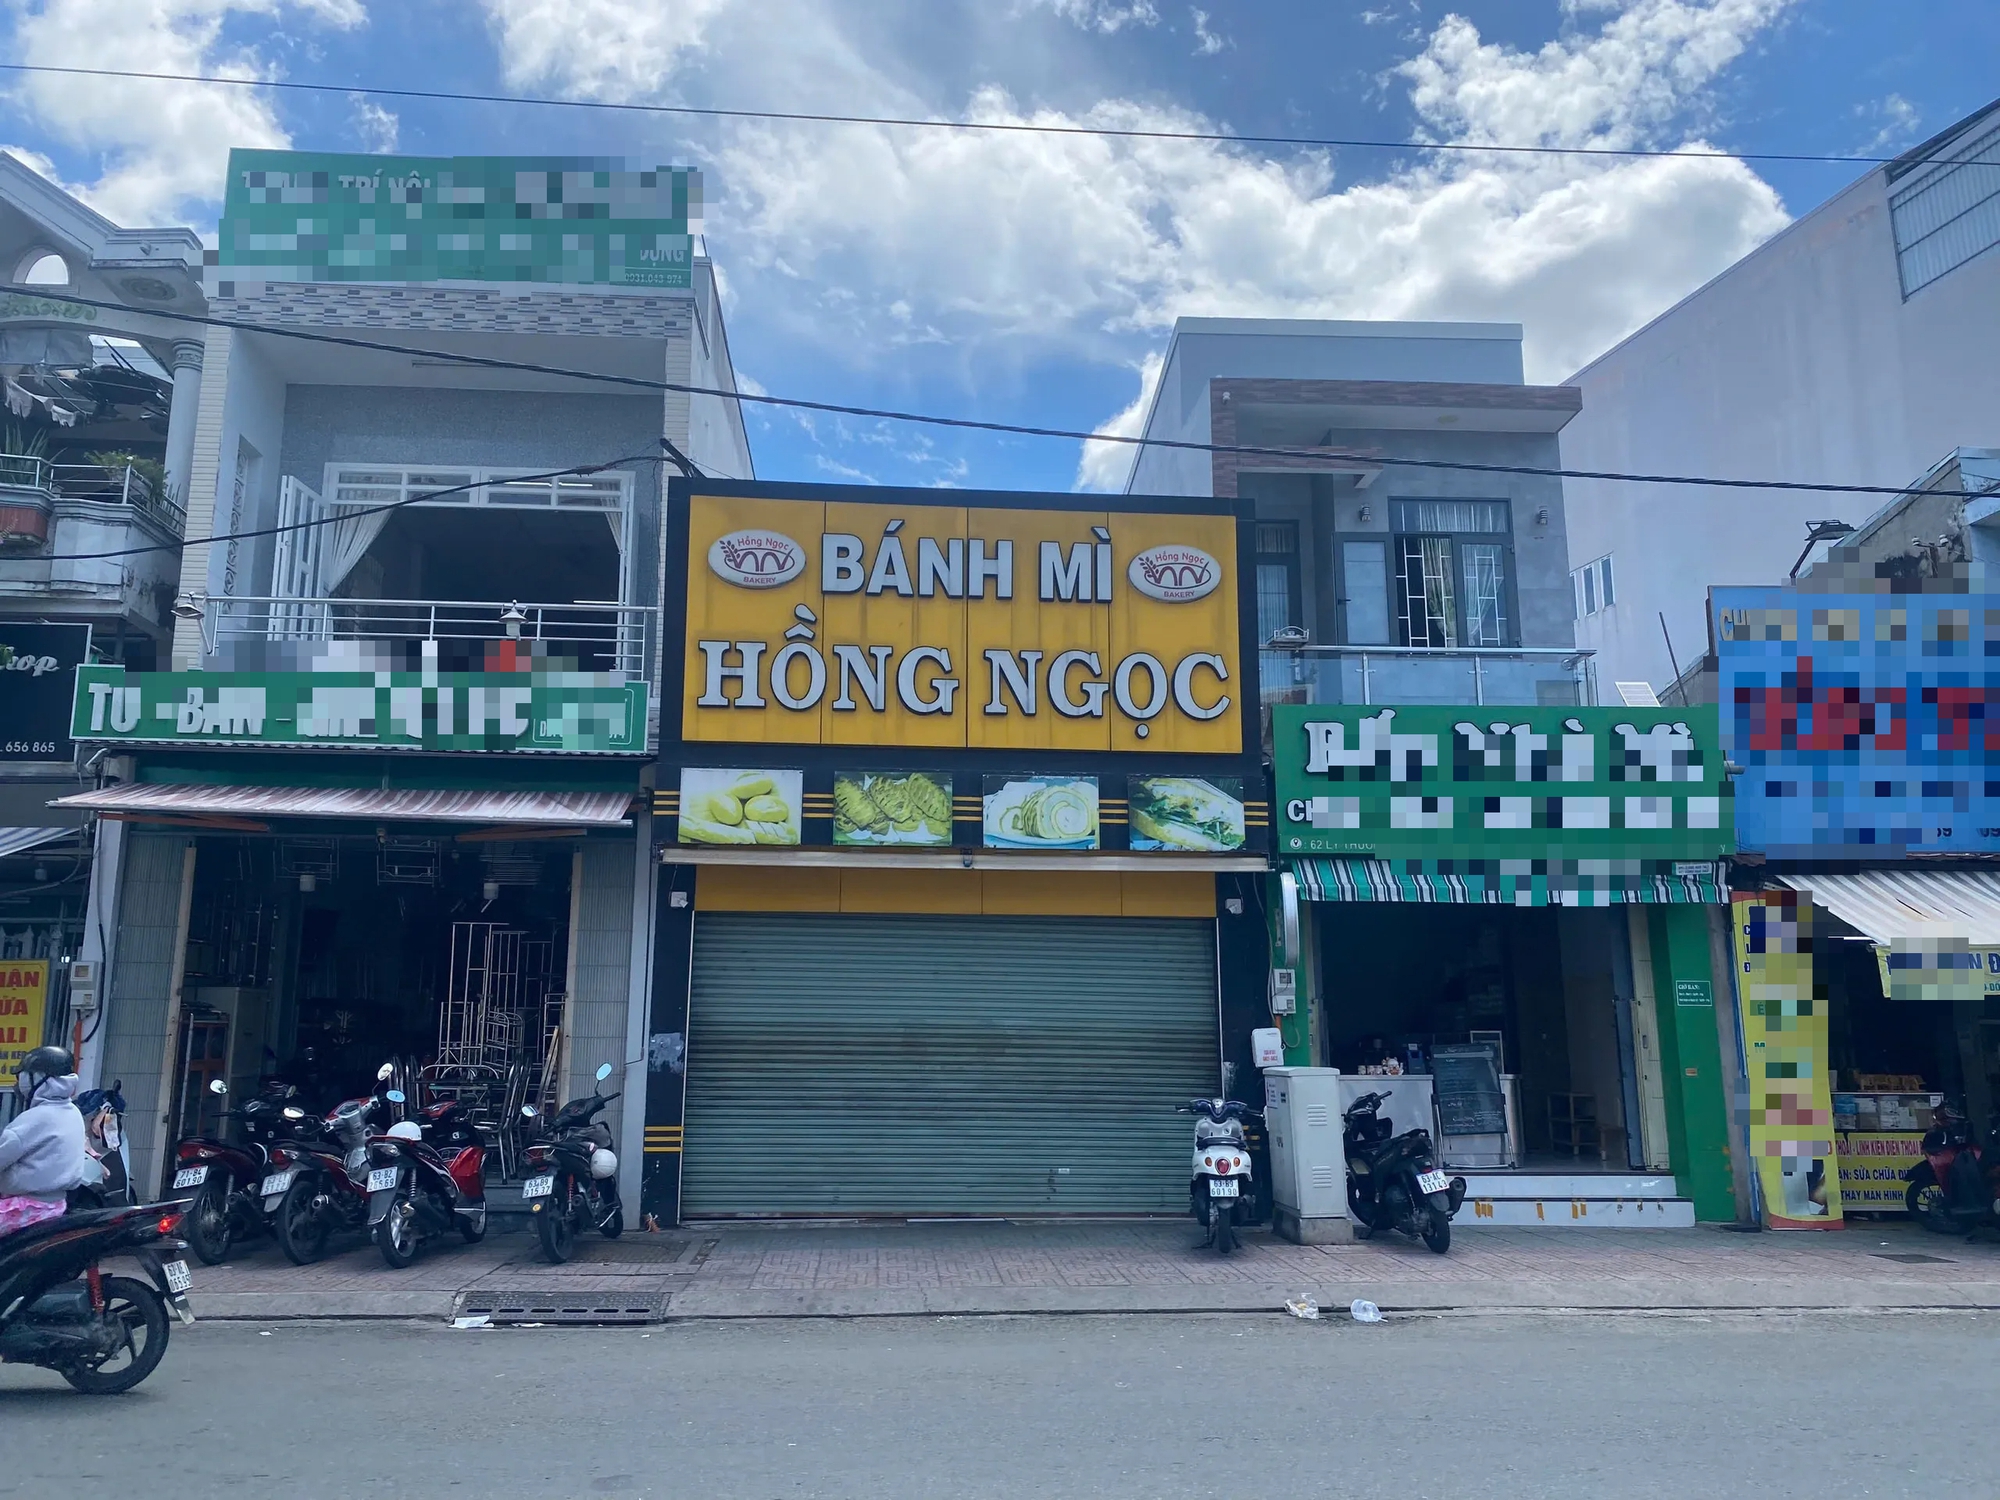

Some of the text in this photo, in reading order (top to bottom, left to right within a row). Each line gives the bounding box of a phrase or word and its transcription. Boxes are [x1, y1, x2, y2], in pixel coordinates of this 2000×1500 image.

[765, 537, 790, 551] Ngọc
[822, 519, 1113, 604] BÁNH MÌ
[1181, 552, 1205, 564] Ngọc
[743, 576, 777, 584] BAKERY
[1163, 590, 1196, 598] BAKERY
[697, 603, 1231, 739] HỒNG NGỌC
[5, 741, 56, 753] 656 865
[1310, 840, 1323, 850] 62
